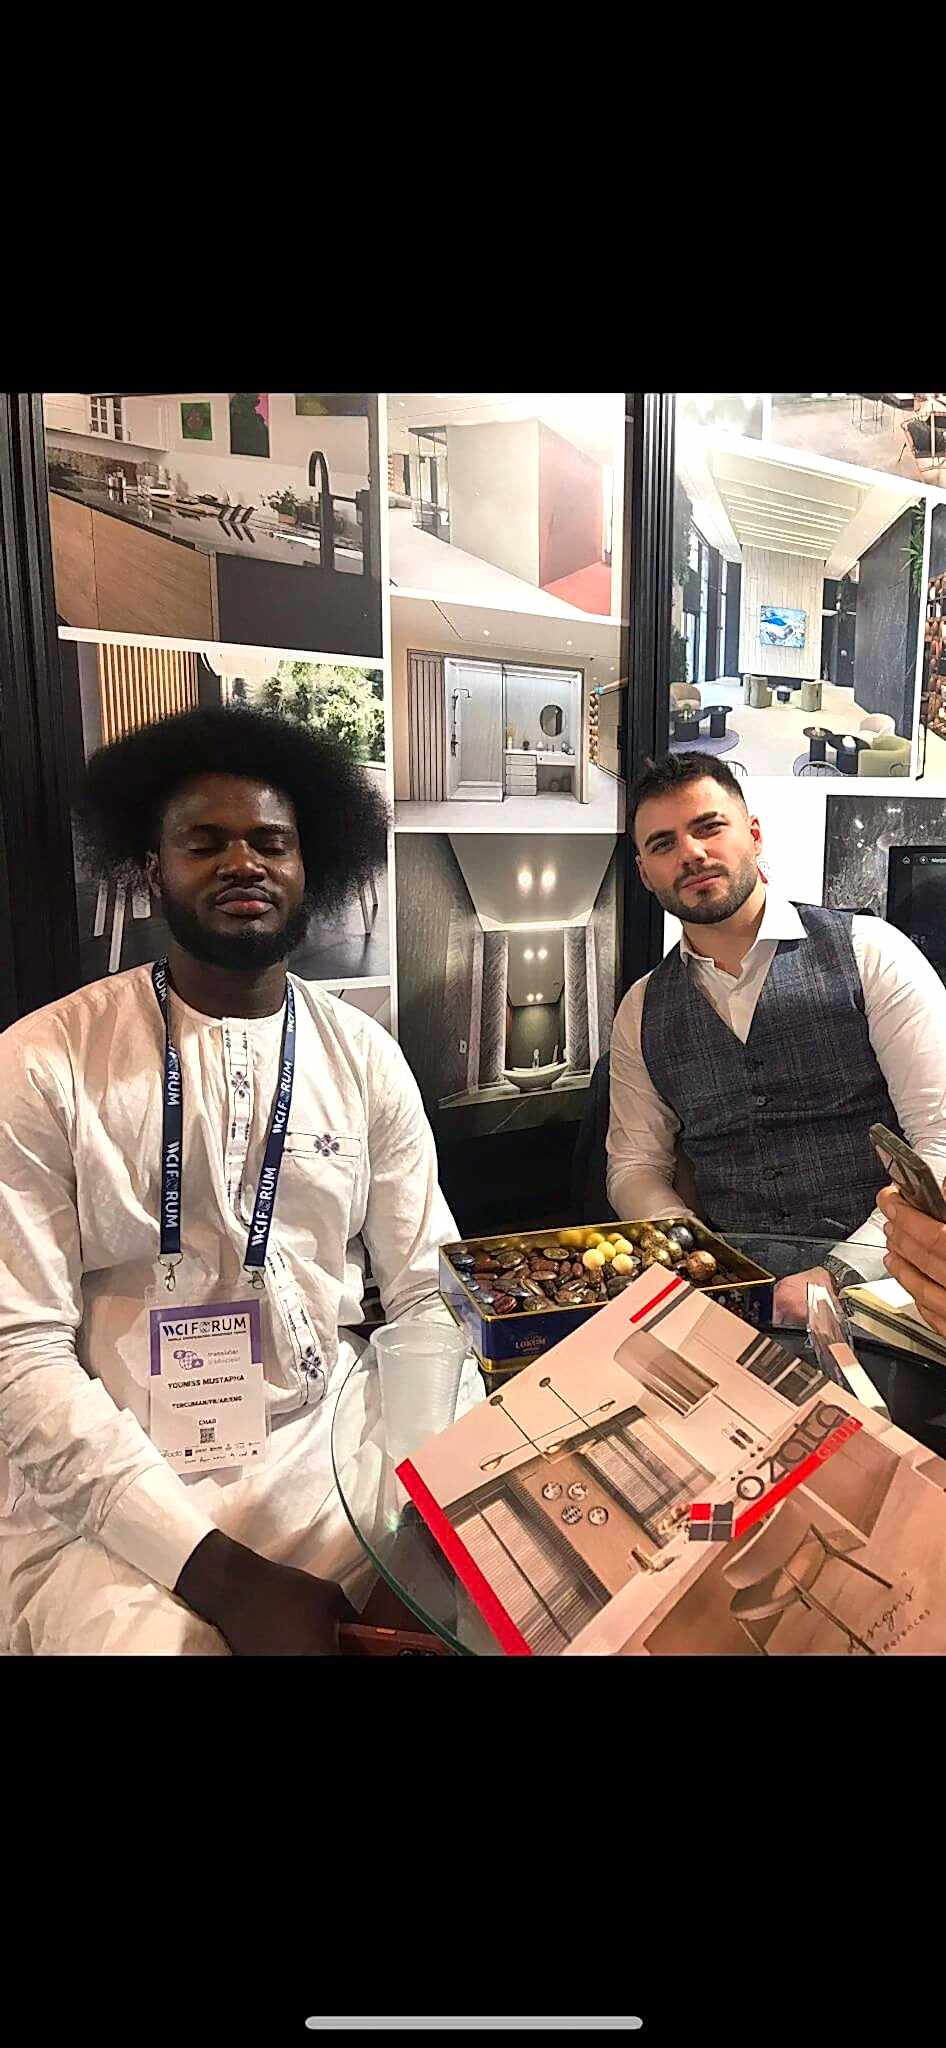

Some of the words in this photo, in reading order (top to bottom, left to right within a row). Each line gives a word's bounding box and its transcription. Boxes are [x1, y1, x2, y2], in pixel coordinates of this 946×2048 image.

[163, 1323, 188, 1336] WCI
[191, 1317, 246, 1334] FORUM
[202, 1374, 245, 1385] MUSTAPHA
